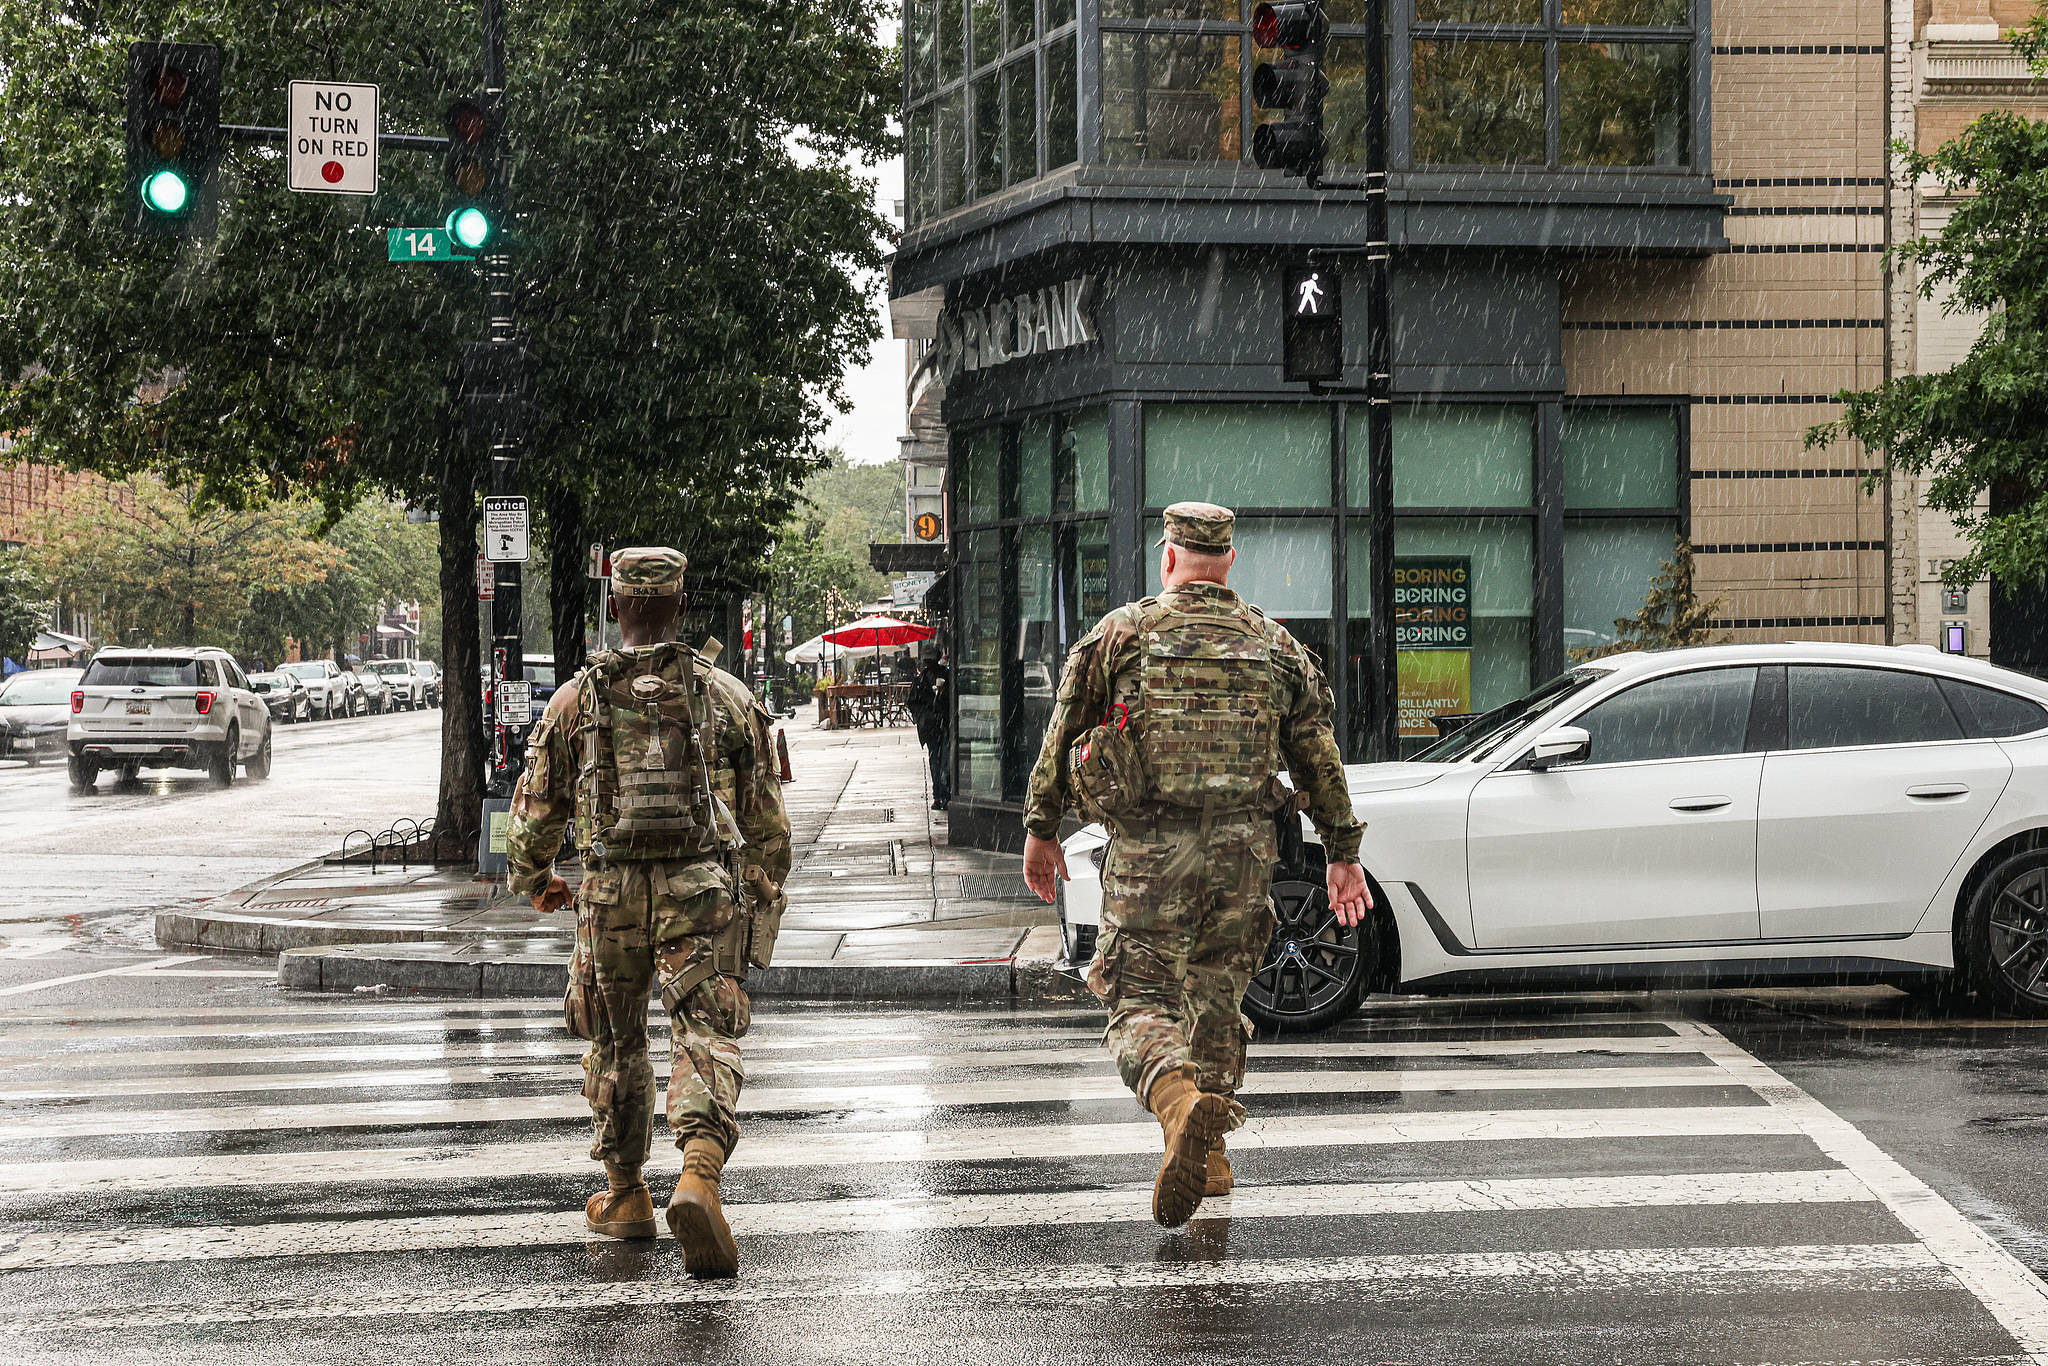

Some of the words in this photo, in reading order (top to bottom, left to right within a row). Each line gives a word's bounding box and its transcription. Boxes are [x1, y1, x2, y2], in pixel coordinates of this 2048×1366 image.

[315, 91, 352, 112] NO
[309, 116, 358, 135] TURN
[298, 138, 323, 155] ON
[332, 140, 368, 157] RED
[404, 232, 437, 257] 14
[1014, 274, 1092, 358] BANK
[486, 502, 526, 511] NOTICE
[918, 515, 936, 538] 9
[1394, 568, 1467, 584] BORING
[1395, 587, 1467, 603] BORING
[1395, 607, 1467, 622] BORING
[1395, 626, 1467, 642] BORING
[1398, 698, 1460, 708] RILLIANTLY
[1398, 709, 1436, 719] ORING
[1398, 719, 1426, 729] INCE
